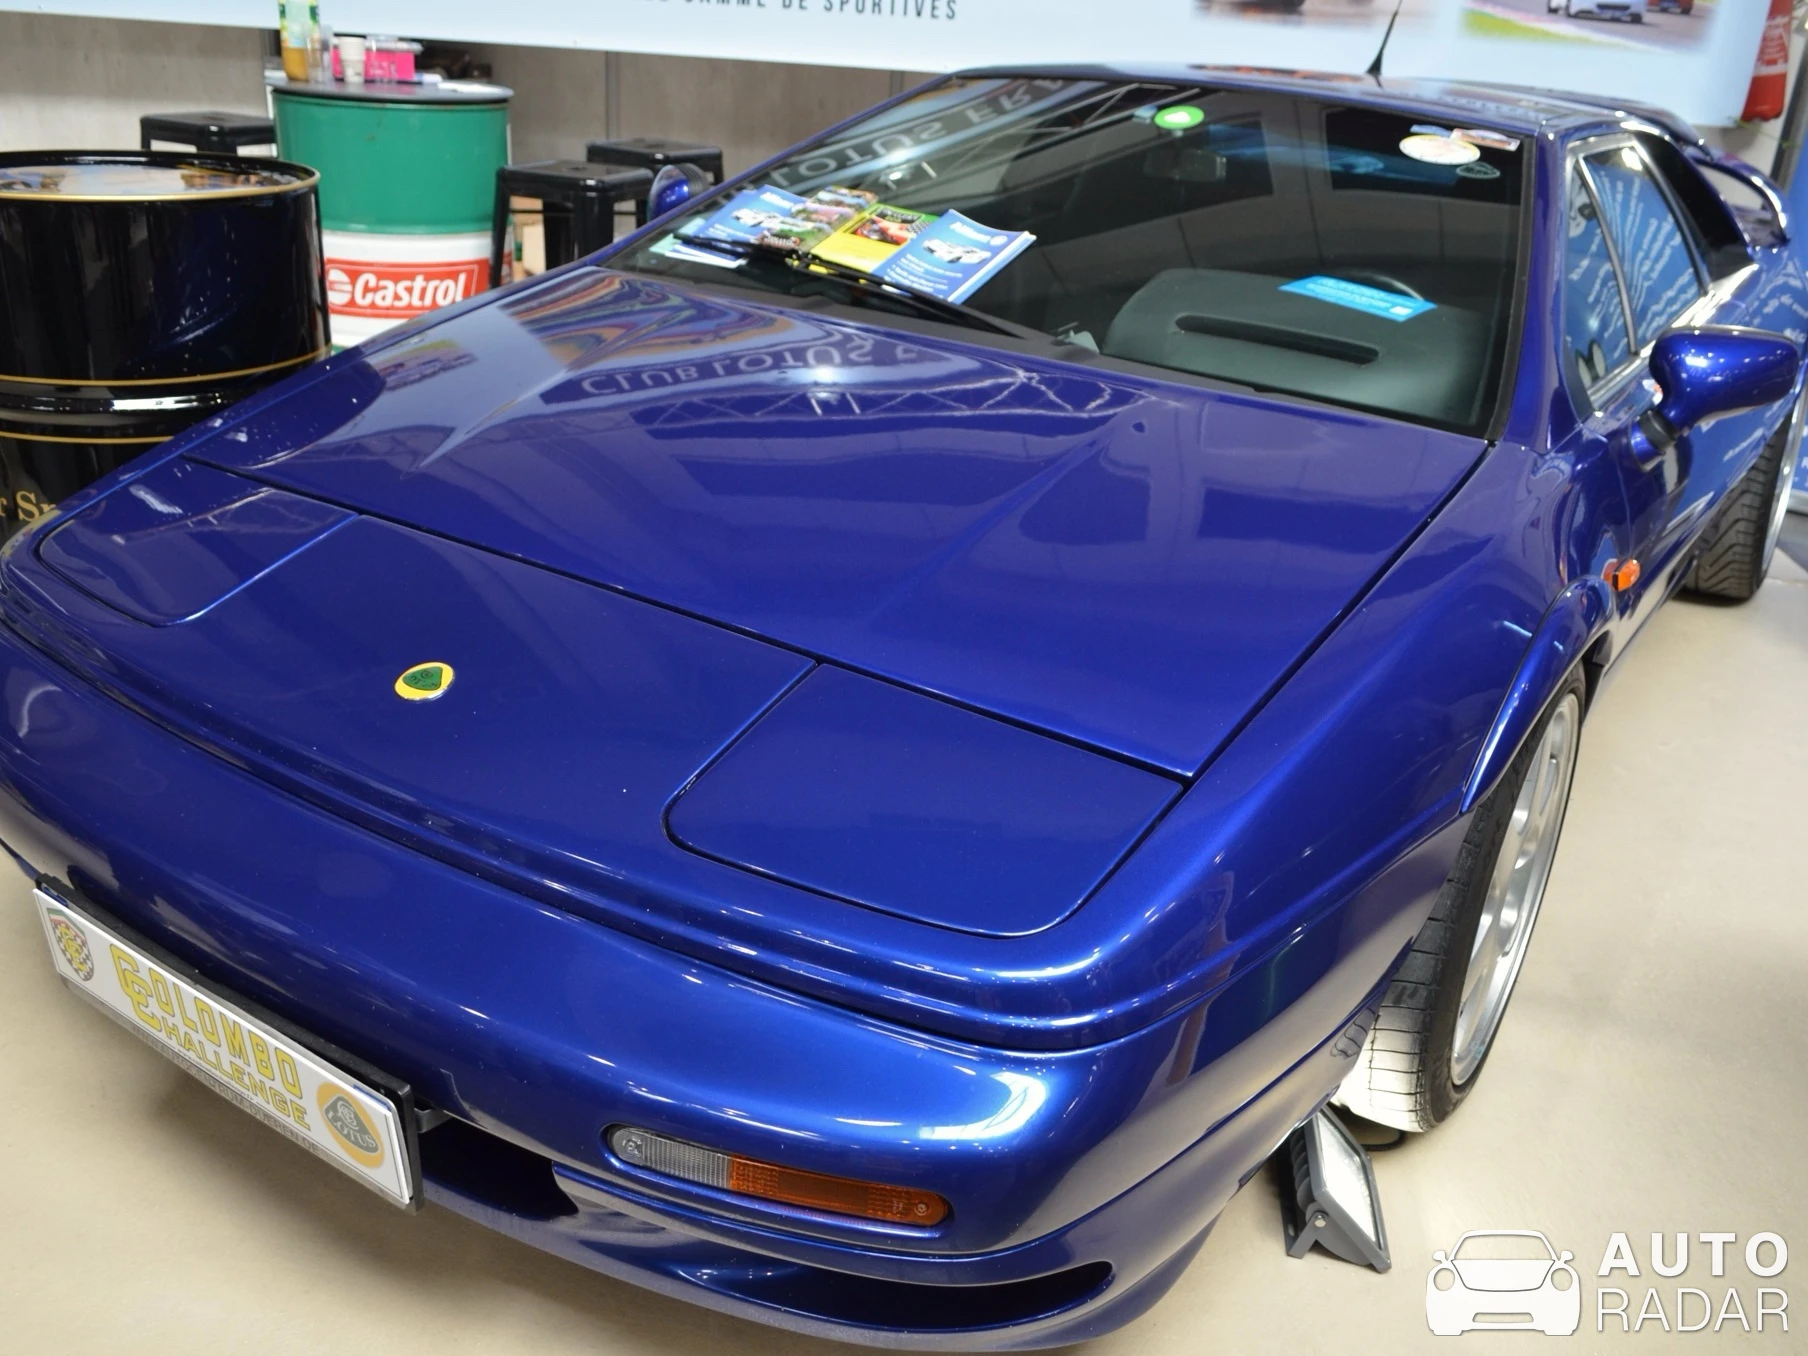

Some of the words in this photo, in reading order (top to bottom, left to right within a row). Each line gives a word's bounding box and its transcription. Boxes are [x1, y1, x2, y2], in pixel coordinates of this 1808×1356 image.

[823, 0, 957, 20] SPORTIVES
[354, 272, 467, 308] Castrol
[327, 1109, 377, 1148] LOTUS
